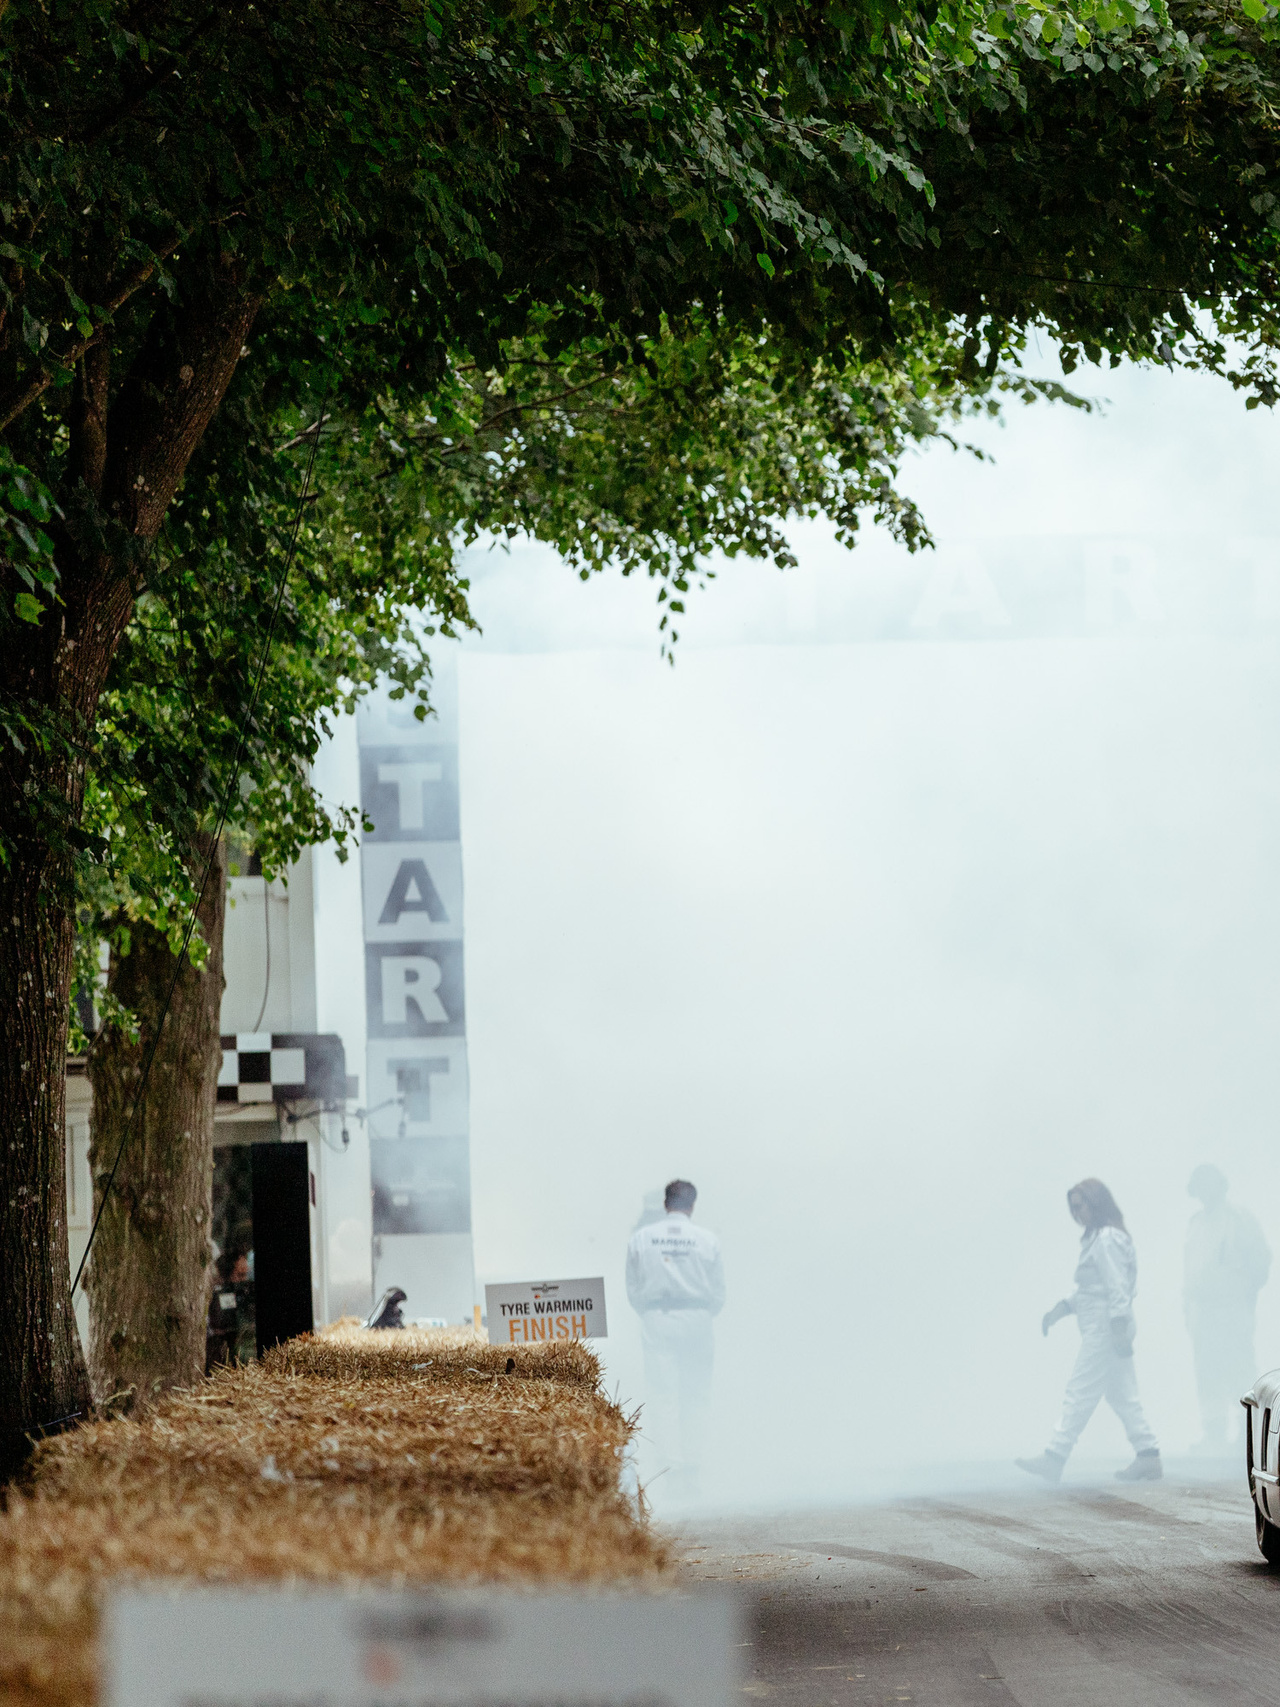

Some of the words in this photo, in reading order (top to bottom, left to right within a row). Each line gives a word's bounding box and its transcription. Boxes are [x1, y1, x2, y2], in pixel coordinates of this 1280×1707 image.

[500, 1302, 530, 1316] TYRE
[533, 1298, 593, 1315] WARMING
[508, 1314, 587, 1342] FINISH
